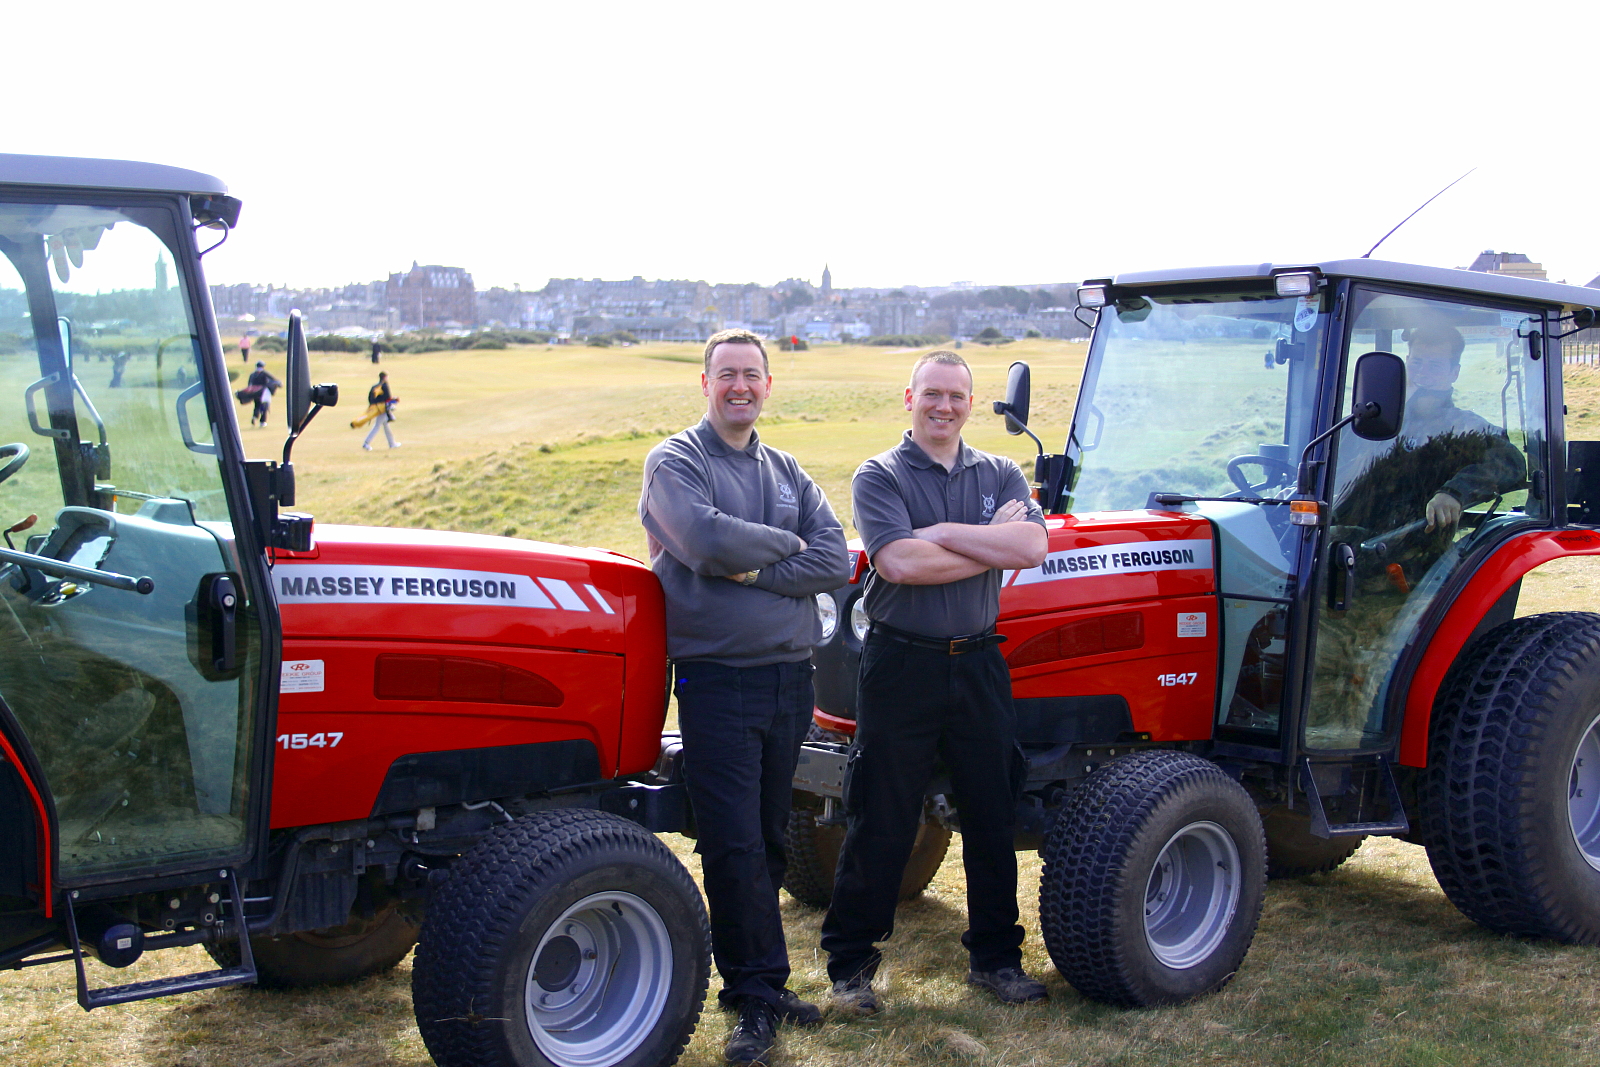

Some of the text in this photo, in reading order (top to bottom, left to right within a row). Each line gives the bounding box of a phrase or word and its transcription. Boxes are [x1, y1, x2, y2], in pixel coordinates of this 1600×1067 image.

[1041, 549, 1195, 576] MASSEY FERGUSON
[281, 576, 517, 599] MASSEY FERGUSON
[1157, 672, 1198, 687] 1547
[276, 732, 344, 750] 1547
